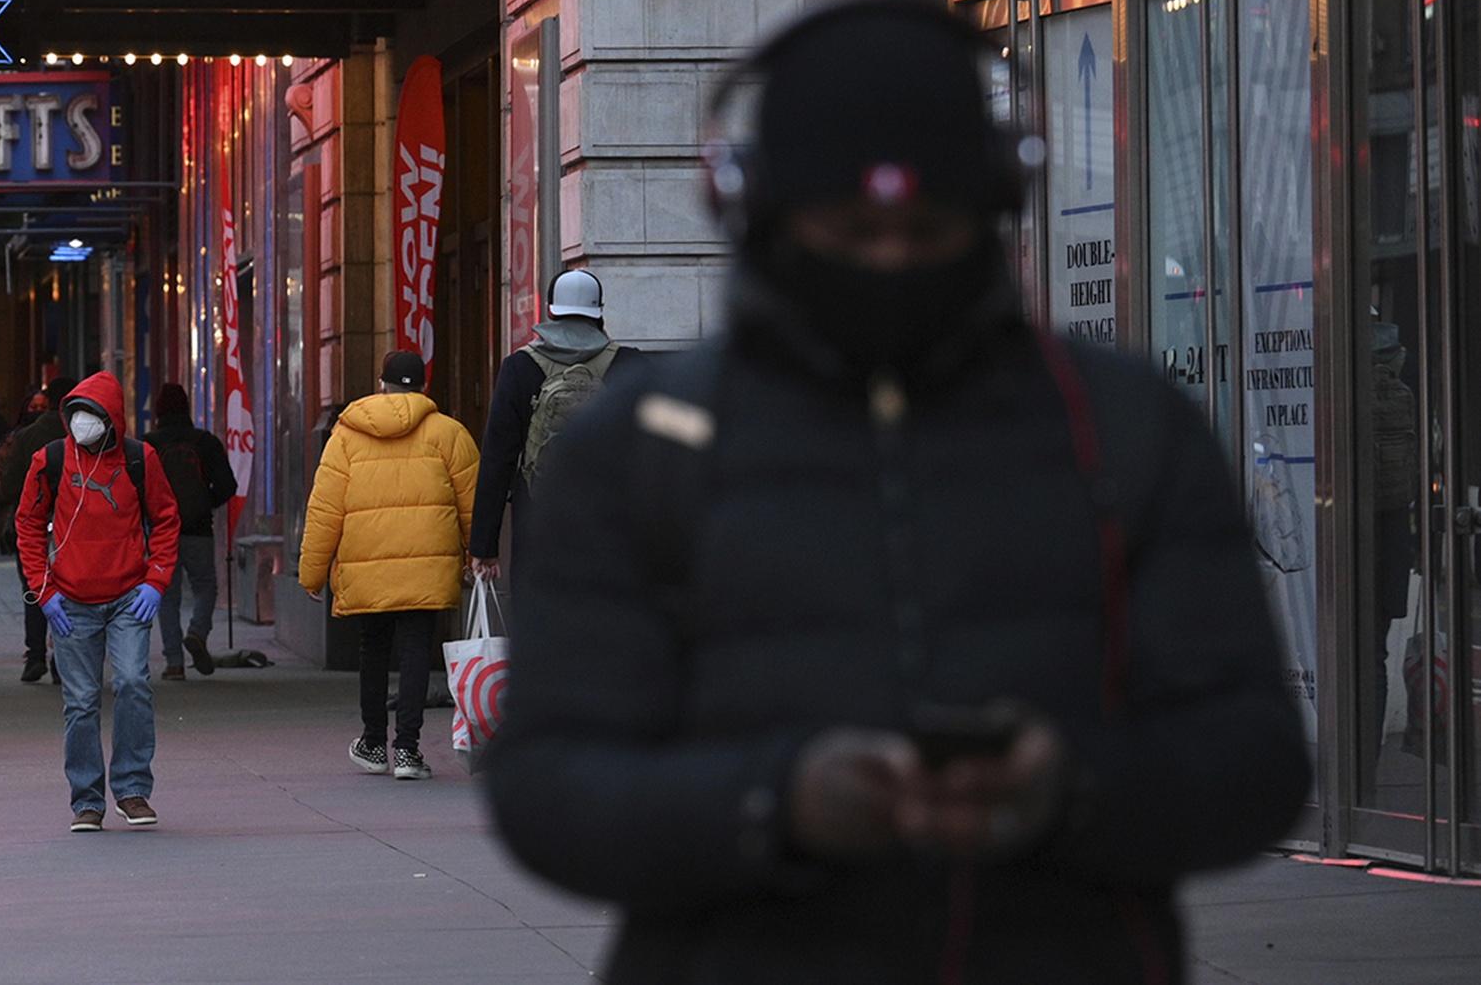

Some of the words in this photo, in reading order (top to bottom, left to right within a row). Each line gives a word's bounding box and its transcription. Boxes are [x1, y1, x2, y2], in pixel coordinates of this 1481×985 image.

[1066, 239, 1115, 269] DOUBLE-
[1070, 278, 1112, 307] HEIGHT
[1255, 329, 1314, 354] EXCEPTIONA
[1247, 366, 1314, 391] INFRASTRUCTU
[1277, 403, 1309, 426] PLACE
